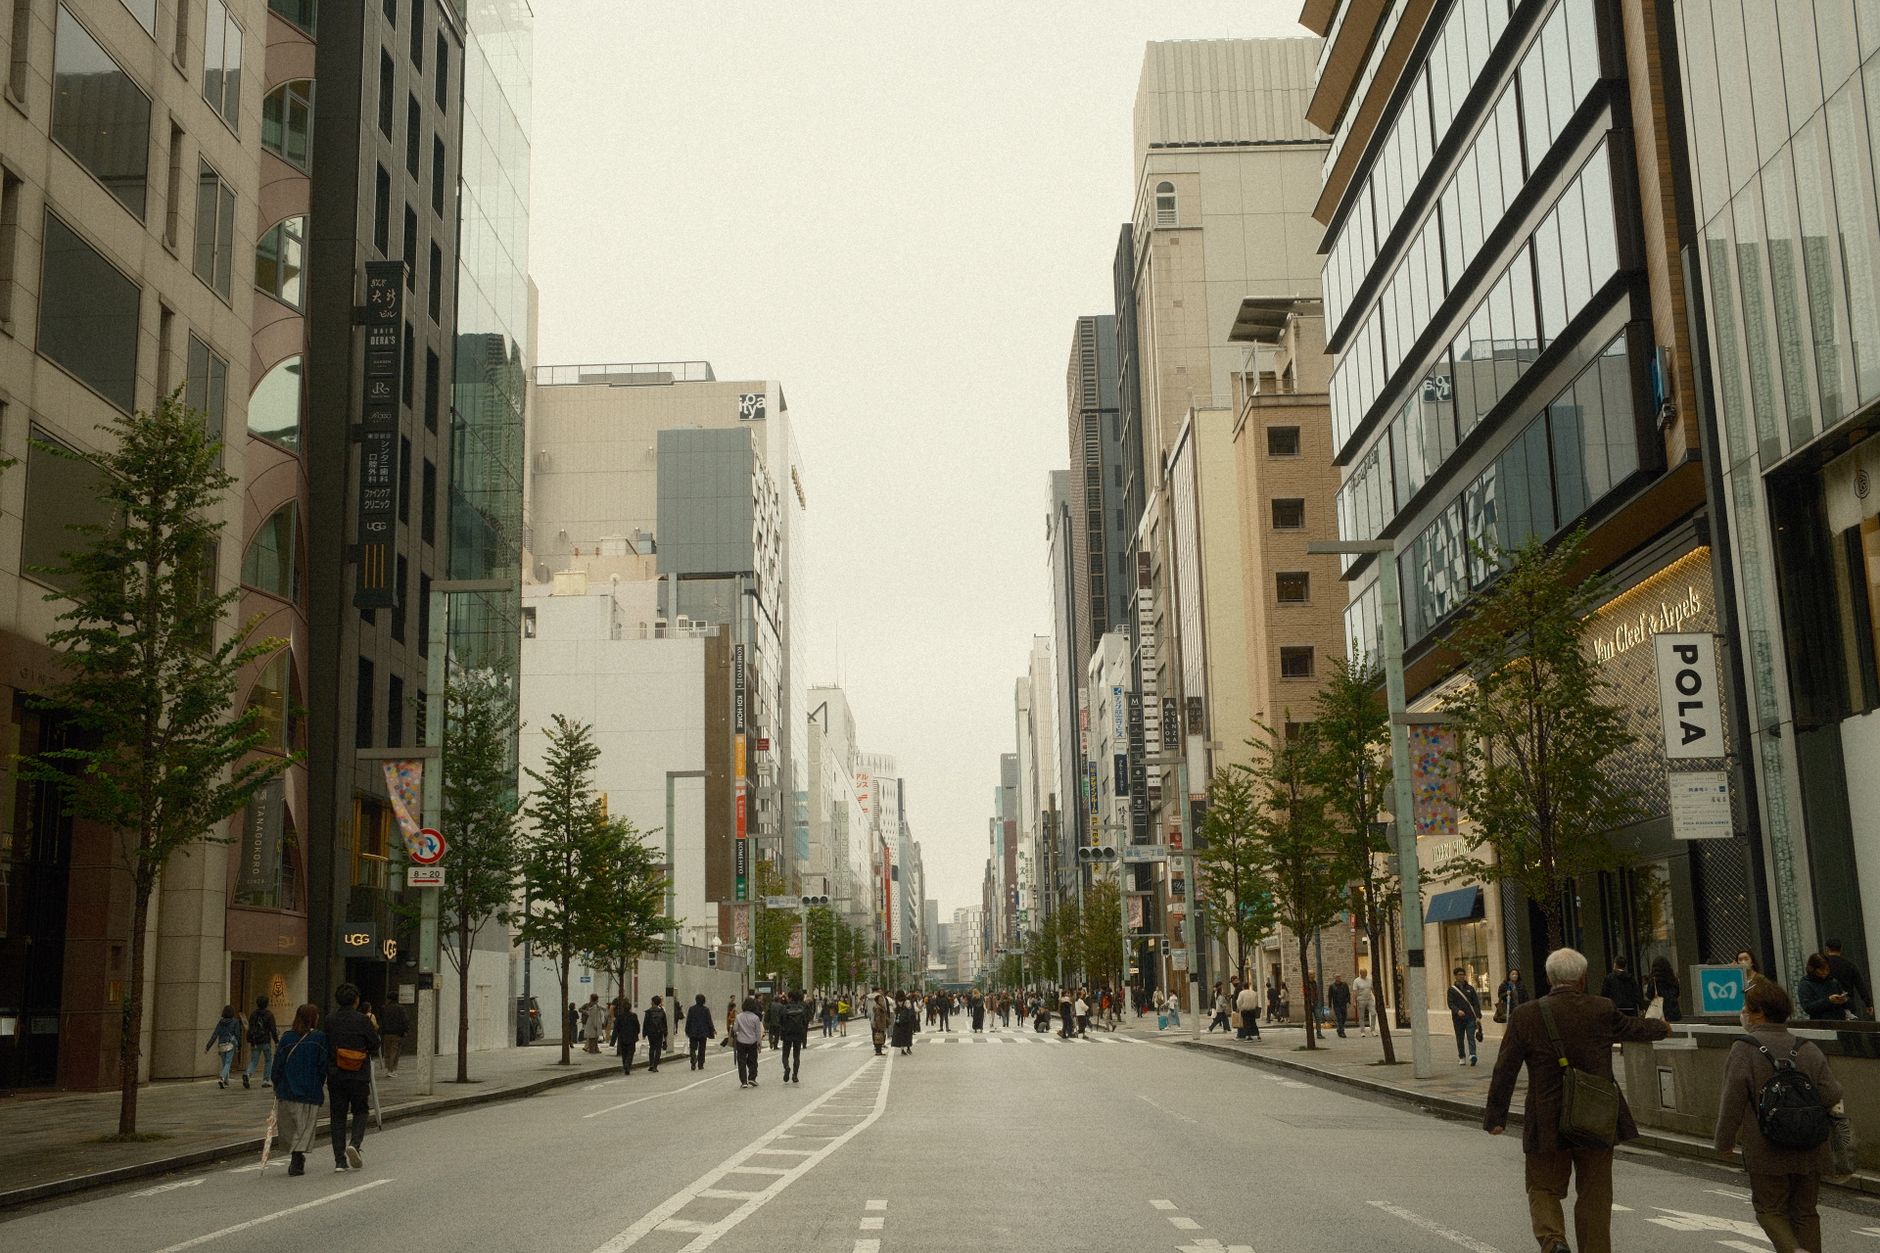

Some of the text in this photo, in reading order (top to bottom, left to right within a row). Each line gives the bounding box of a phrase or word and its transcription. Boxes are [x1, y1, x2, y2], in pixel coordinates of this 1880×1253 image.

[366, 522, 387, 532] UGG
[1593, 637, 1614, 665] Van
[1615, 613, 1646, 653] Cleef
[1659, 586, 1701, 632] Arpels
[1672, 644, 1706, 746] POLA
[344, 933, 370, 946] UGG
[383, 939, 397, 959] UGG
